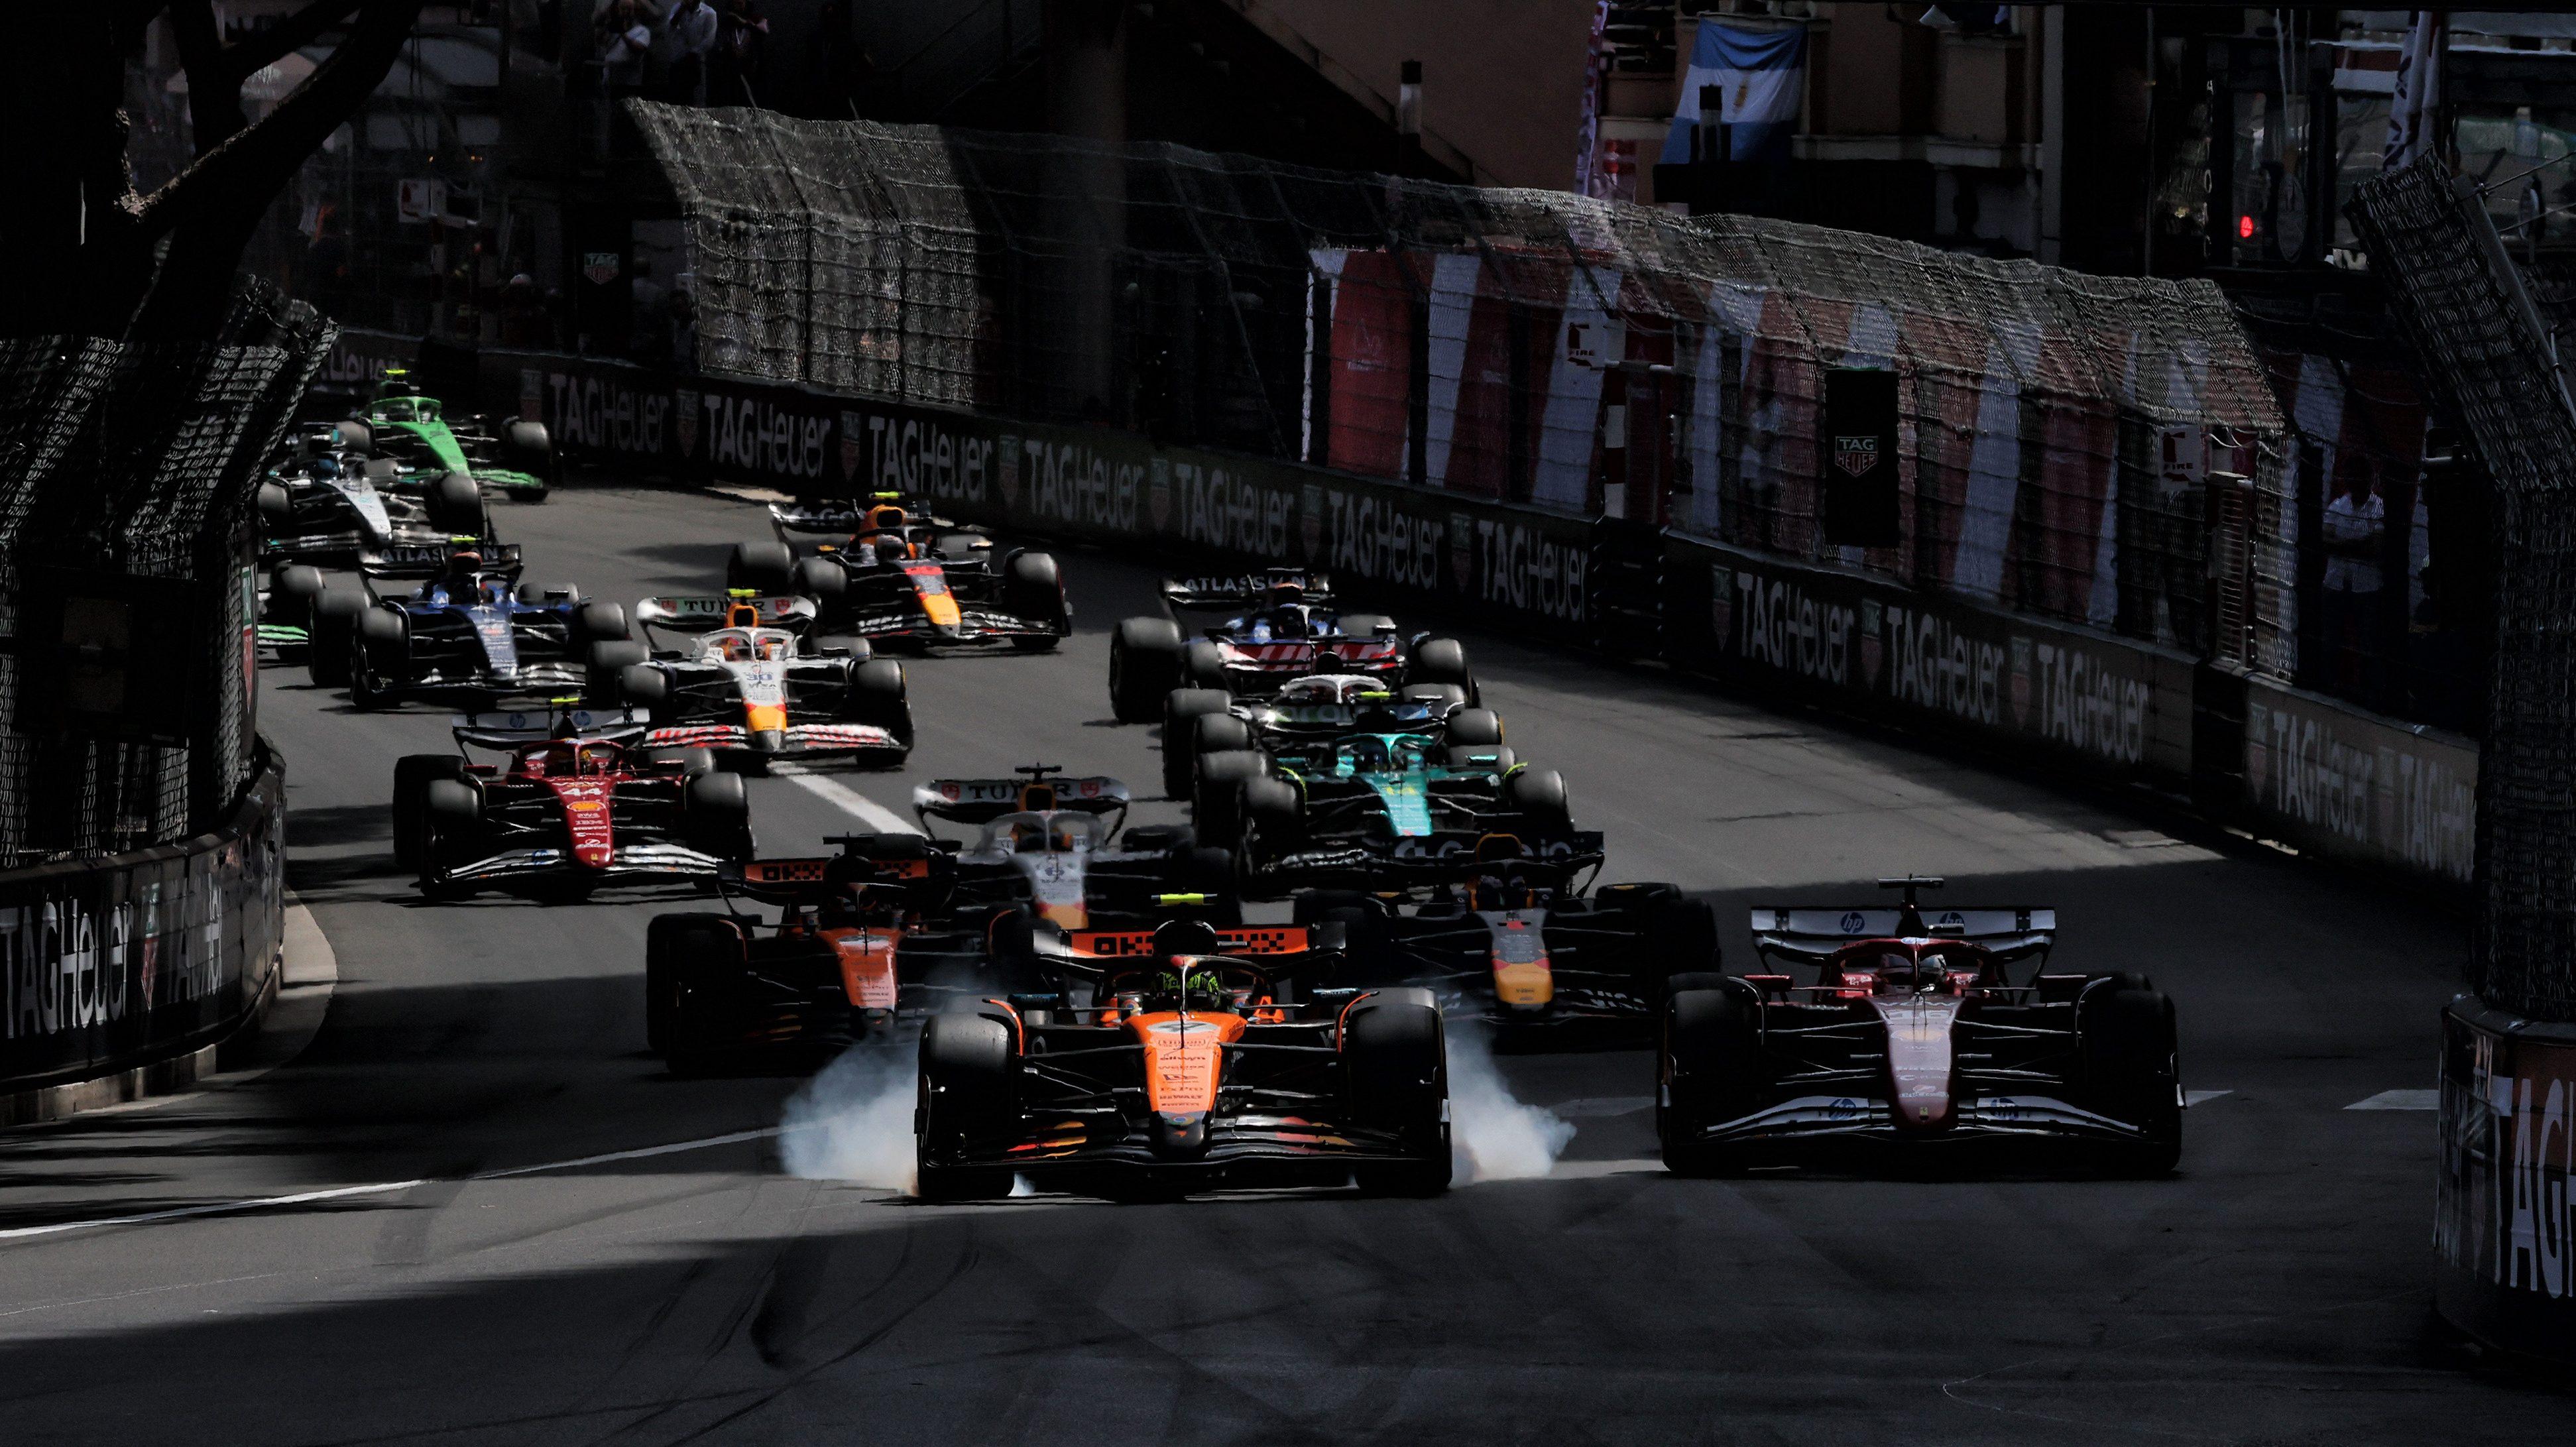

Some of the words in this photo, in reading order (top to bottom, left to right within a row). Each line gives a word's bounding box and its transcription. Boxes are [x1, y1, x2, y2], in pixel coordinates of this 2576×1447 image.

[704, 394, 831, 478] TAGHeuer
[868, 416, 993, 502] TAGHeuer
[1838, 453, 1876, 473] HEUER
[1839, 438, 1874, 451] TAG
[1025, 439, 1144, 531] TAGHeuer
[1175, 464, 1295, 557] TAGHeuer
[380, 548, 504, 563] ATLASSAN
[1184, 576, 1307, 592] ATLASSIN
[1328, 491, 1444, 590] TAGHeuer
[1478, 520, 1589, 622] TAGHeuer
[684, 600, 766, 613] TUR
[1737, 571, 1854, 685] TAGHeuer
[1887, 605, 2005, 726] TAGHeuer
[2037, 644, 2148, 766] TAGHeuer
[968, 783, 1070, 799] TUR
[2273, 711, 2373, 844] TAGHeuer
[2399, 754, 2477, 882] TAGHe
[0, 898, 133, 1039] TAGHeuer
